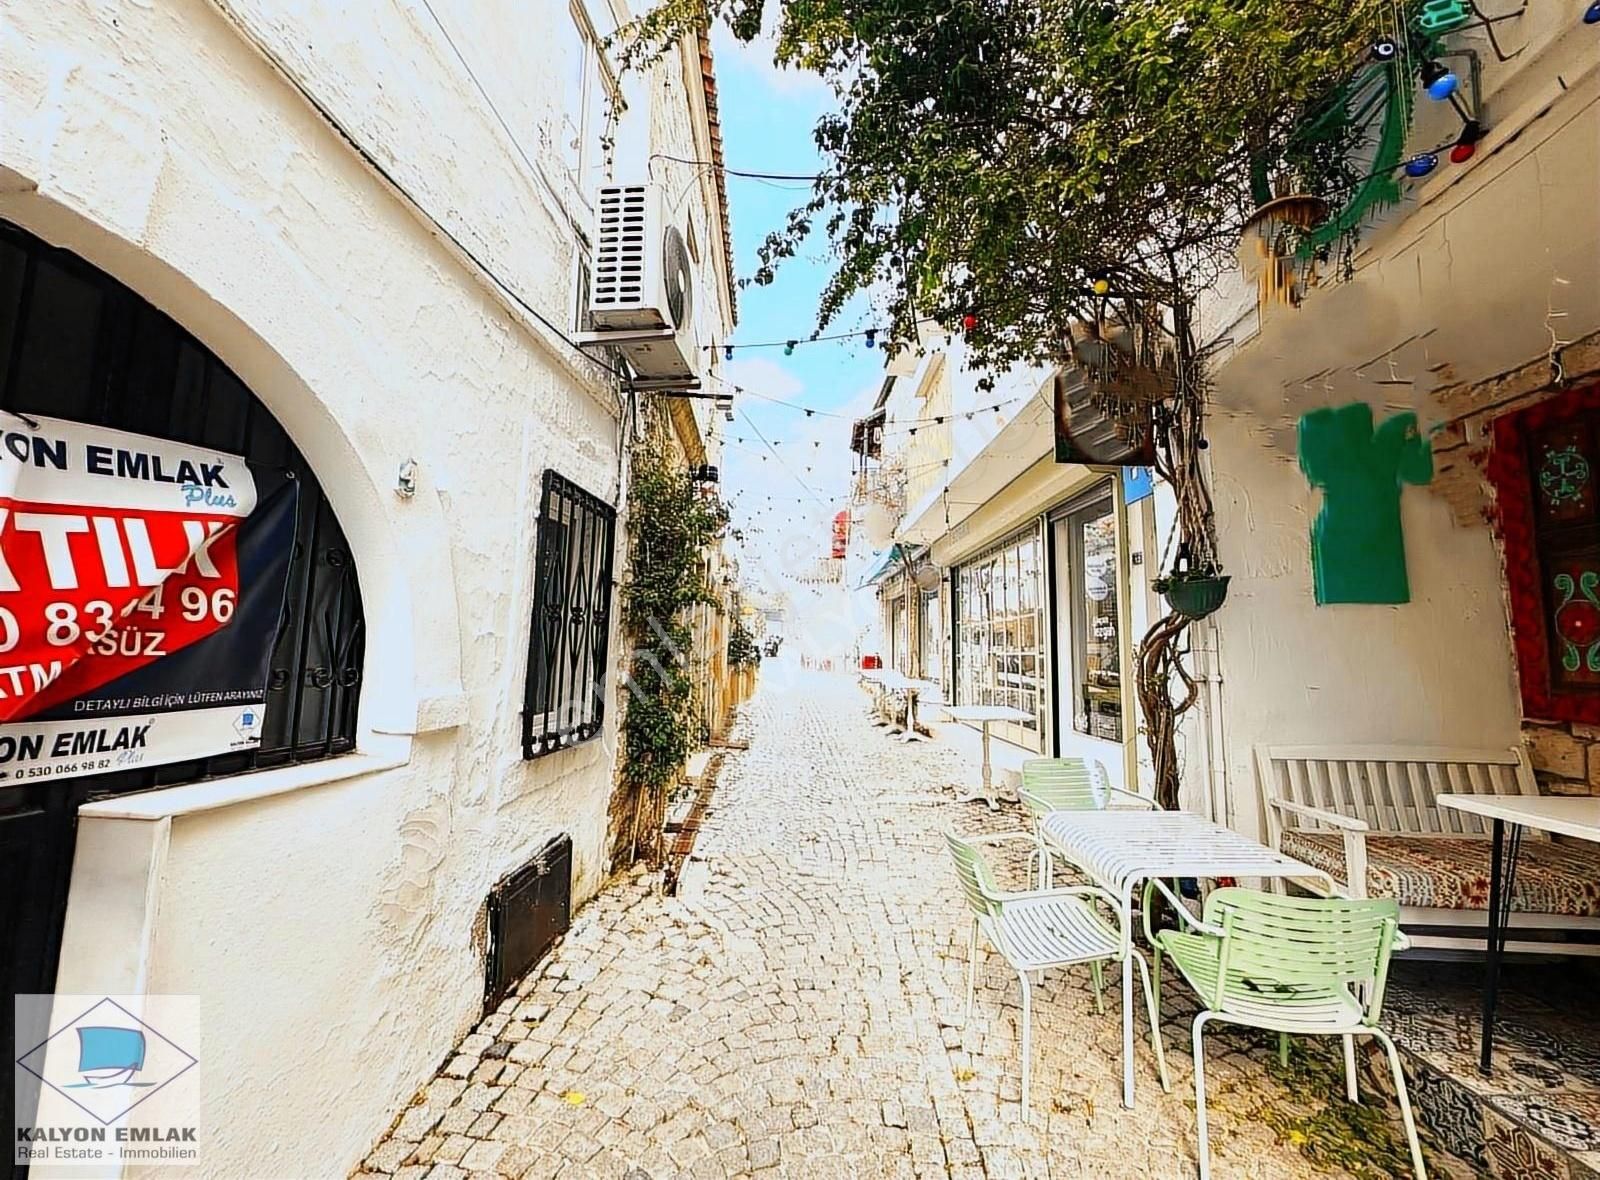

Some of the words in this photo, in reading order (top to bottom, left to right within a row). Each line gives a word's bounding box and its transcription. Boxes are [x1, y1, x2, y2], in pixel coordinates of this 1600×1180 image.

[86, 444, 229, 488] EMLAK
[181, 484, 237, 507] Plus
[181, 587, 235, 623] 96
[74, 697, 130, 712] DETAYLI
[188, 690, 223, 704] LÜTFEN
[50, 724, 151, 758] EMLAK
[28, 766, 51, 778] 530
[55, 764, 78, 774] 066
[81, 760, 95, 771] 98
